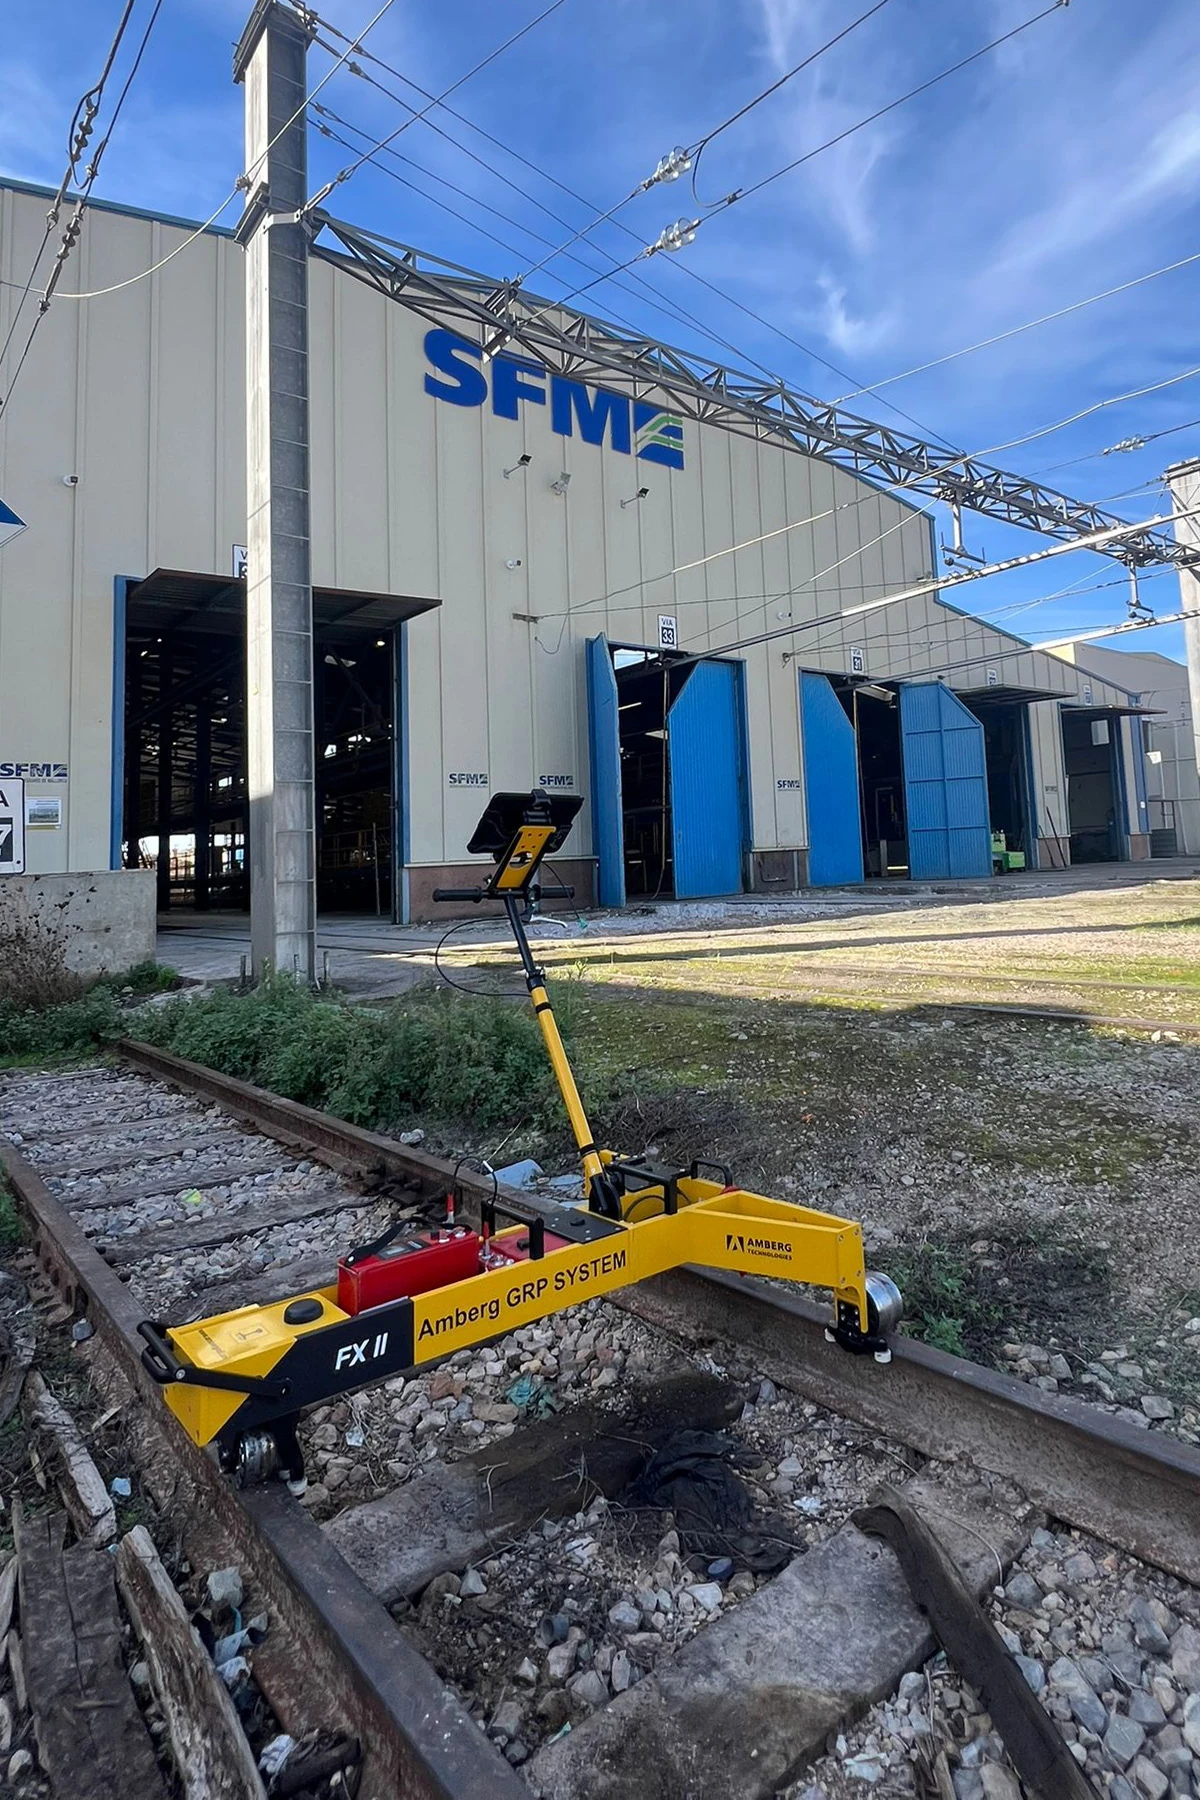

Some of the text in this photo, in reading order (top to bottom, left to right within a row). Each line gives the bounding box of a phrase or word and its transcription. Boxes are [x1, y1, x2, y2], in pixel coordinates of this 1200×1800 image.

[424, 328, 631, 455] SFM
[662, 628, 674, 644] 33
[0, 763, 52, 777] SFM
[449, 773, 479, 784] SFM
[539, 775, 566, 786] SFM
[747, 1238, 792, 1252] AMBERG
[747, 1248, 792, 1261] TECHNOLOGIES
[418, 1250, 626, 1341] Amberg GRP SYSTEM
[335, 1338, 370, 1370] FX
